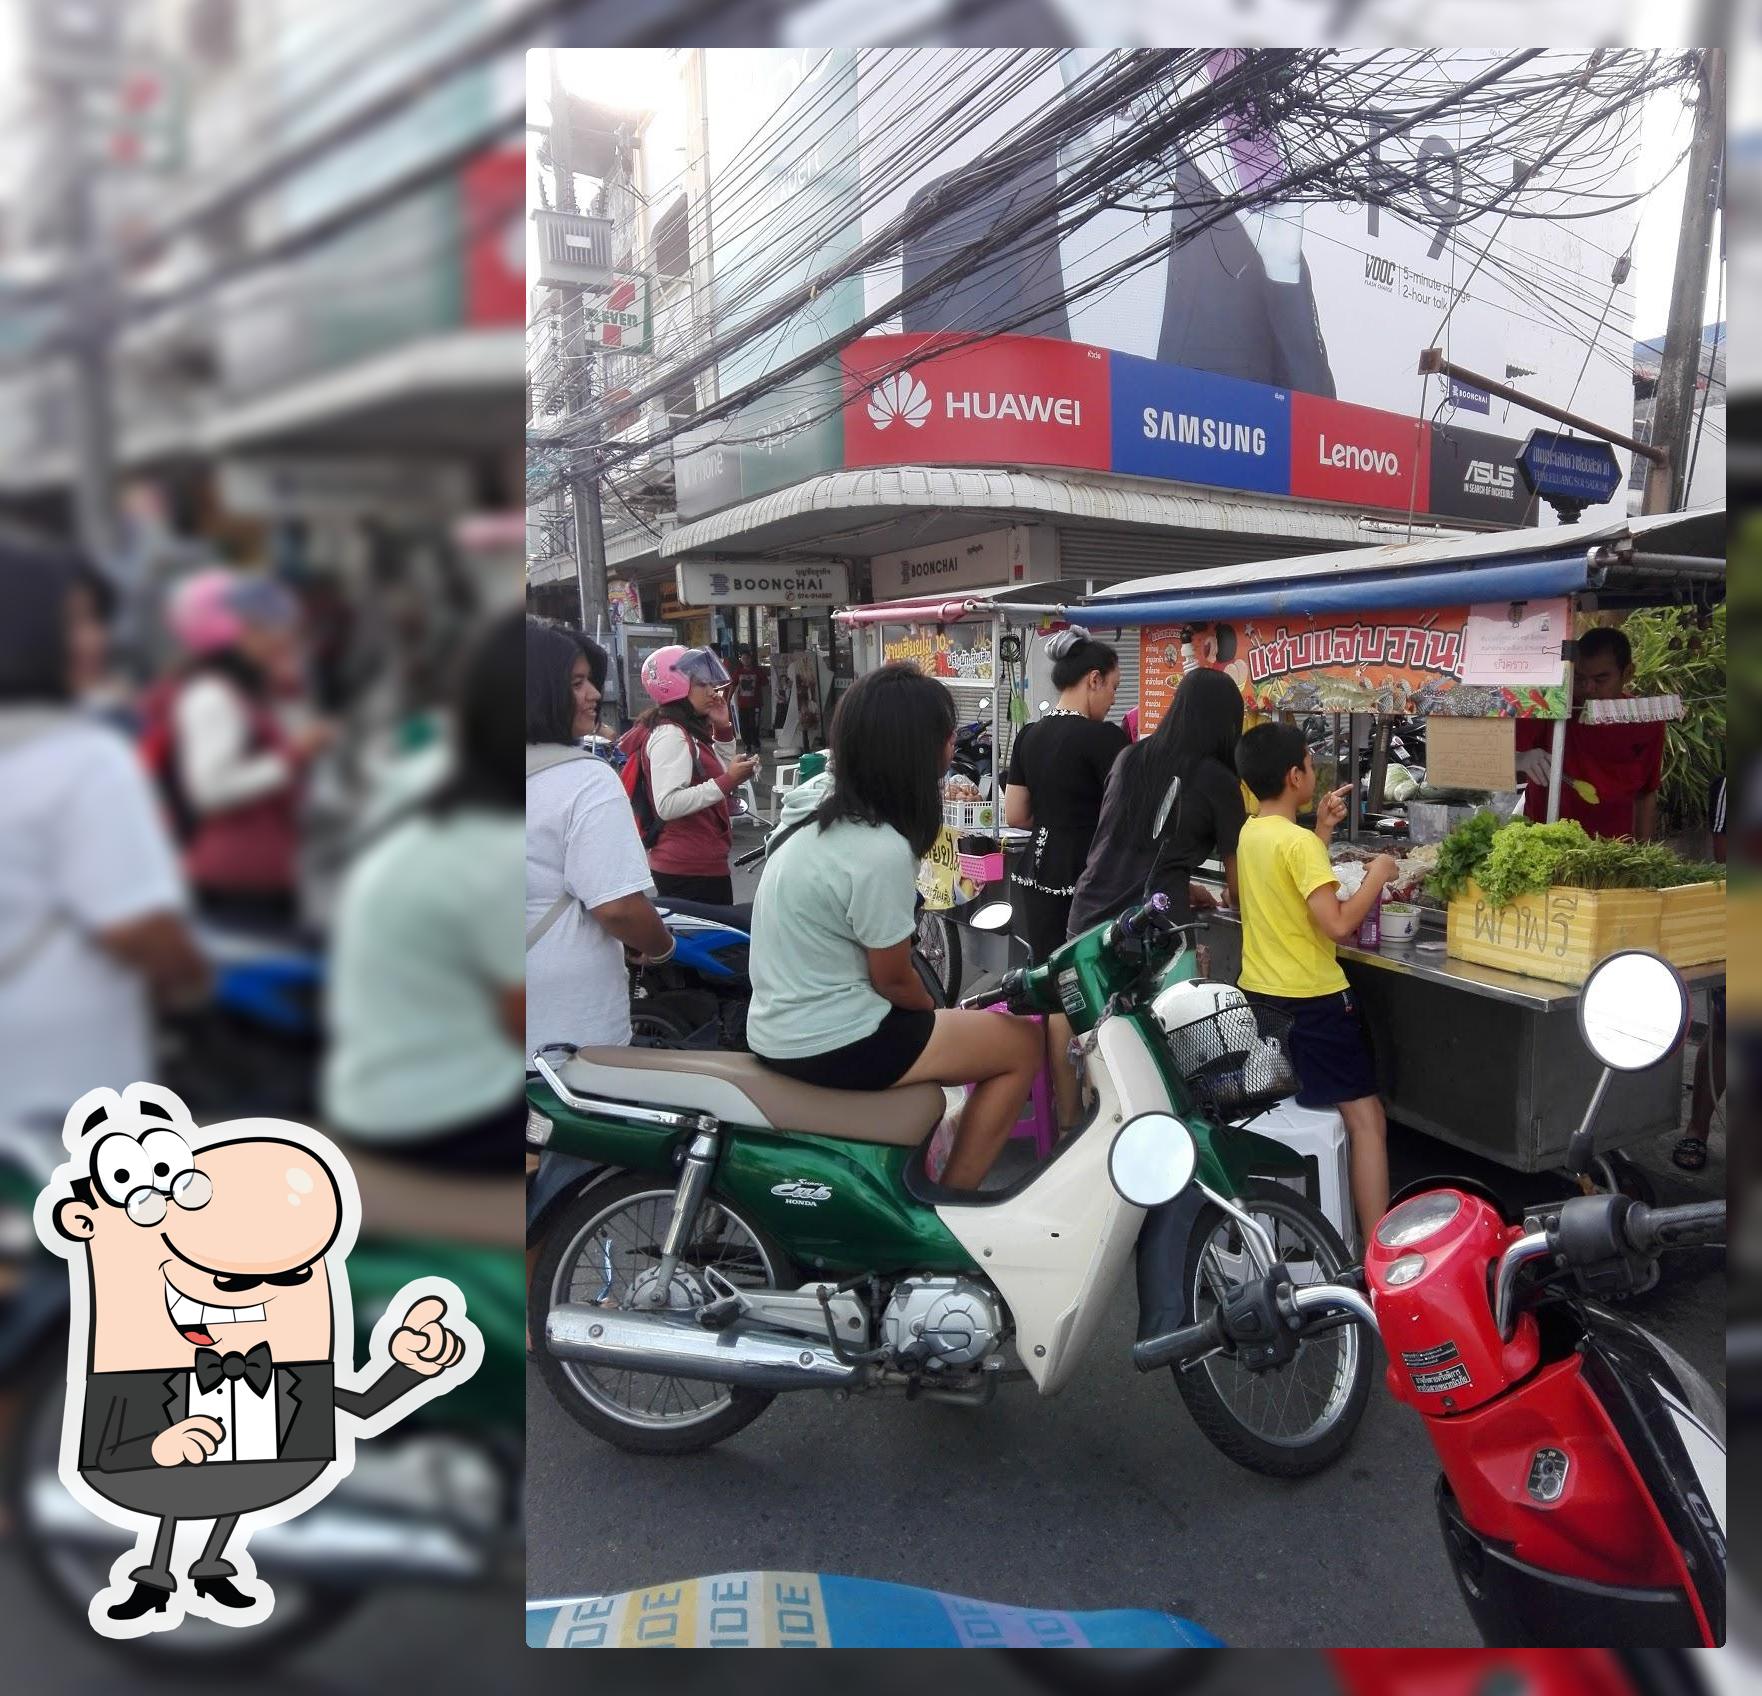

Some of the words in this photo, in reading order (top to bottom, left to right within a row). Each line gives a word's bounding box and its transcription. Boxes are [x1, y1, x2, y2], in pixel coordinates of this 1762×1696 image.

[1364, 254, 1395, 286] VOOC
[1402, 284, 1431, 305] 2-hour
[1433, 296, 1448, 312] talk
[1403, 266, 1441, 291] 5-minute
[1443, 282, 1471, 303] chage
[946, 391, 1081, 426] HUAWEI
[1459, 388, 1489, 405] BOONCHAI
[1143, 407, 1266, 456] SAMSUNG
[1319, 433, 1399, 476] Lenovo
[1464, 460, 1515, 488] ASUS
[911, 556, 959, 578] BOONCHAI
[733, 578, 823, 591] BOONCHAI
[785, 1199, 817, 1207] HONDA
